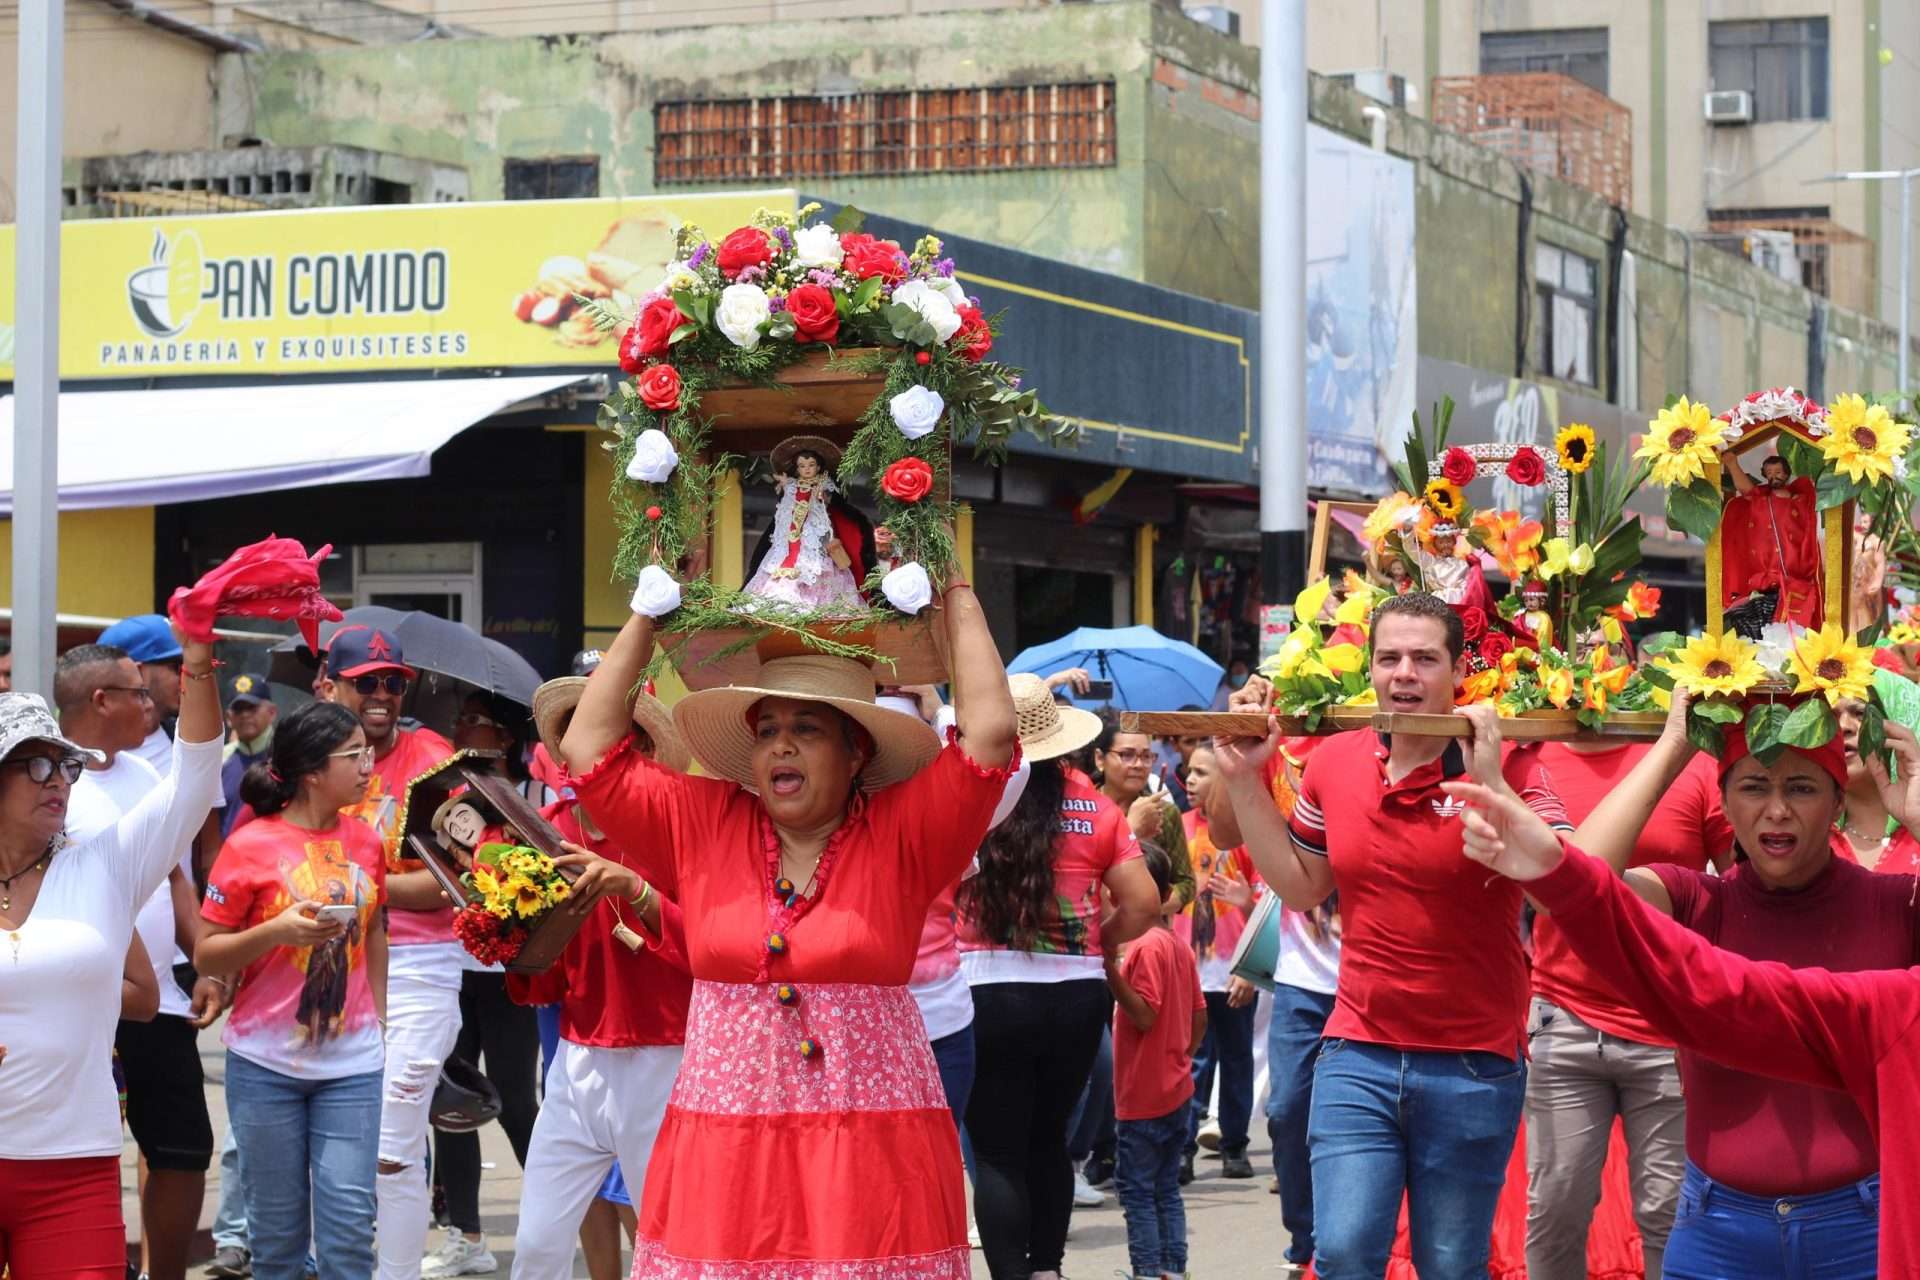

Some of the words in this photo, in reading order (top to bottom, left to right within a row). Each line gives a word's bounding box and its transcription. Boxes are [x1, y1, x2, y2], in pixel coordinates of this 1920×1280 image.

[201, 257, 272, 319] PAN
[289, 250, 446, 316] COMIDO
[255, 340, 266, 359] Y
[281, 334, 466, 359] EXQUISITESES
[1061, 799, 1097, 812] uan
